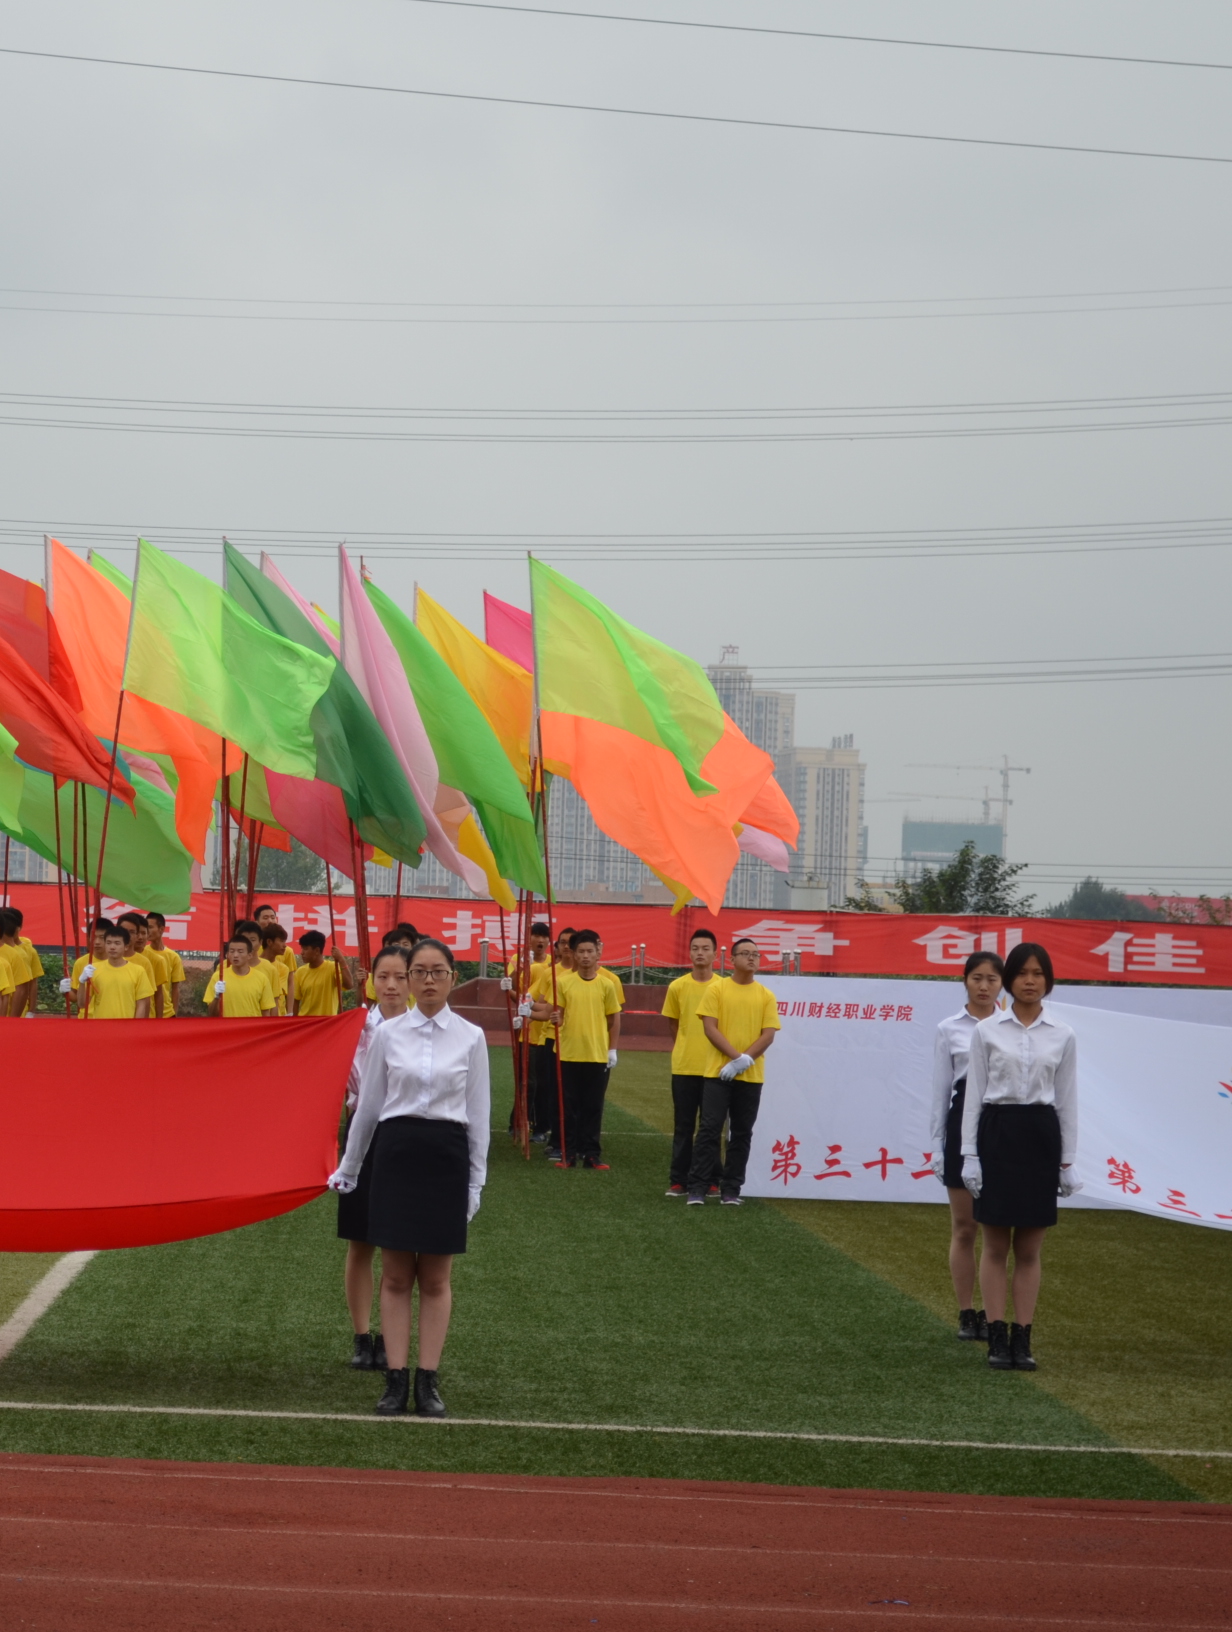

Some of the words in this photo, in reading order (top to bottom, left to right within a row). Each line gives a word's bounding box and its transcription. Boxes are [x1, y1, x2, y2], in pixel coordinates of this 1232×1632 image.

[731, 919, 1206, 973] 争创佳
[776, 1001, 913, 1022] 四川财经职业学院
